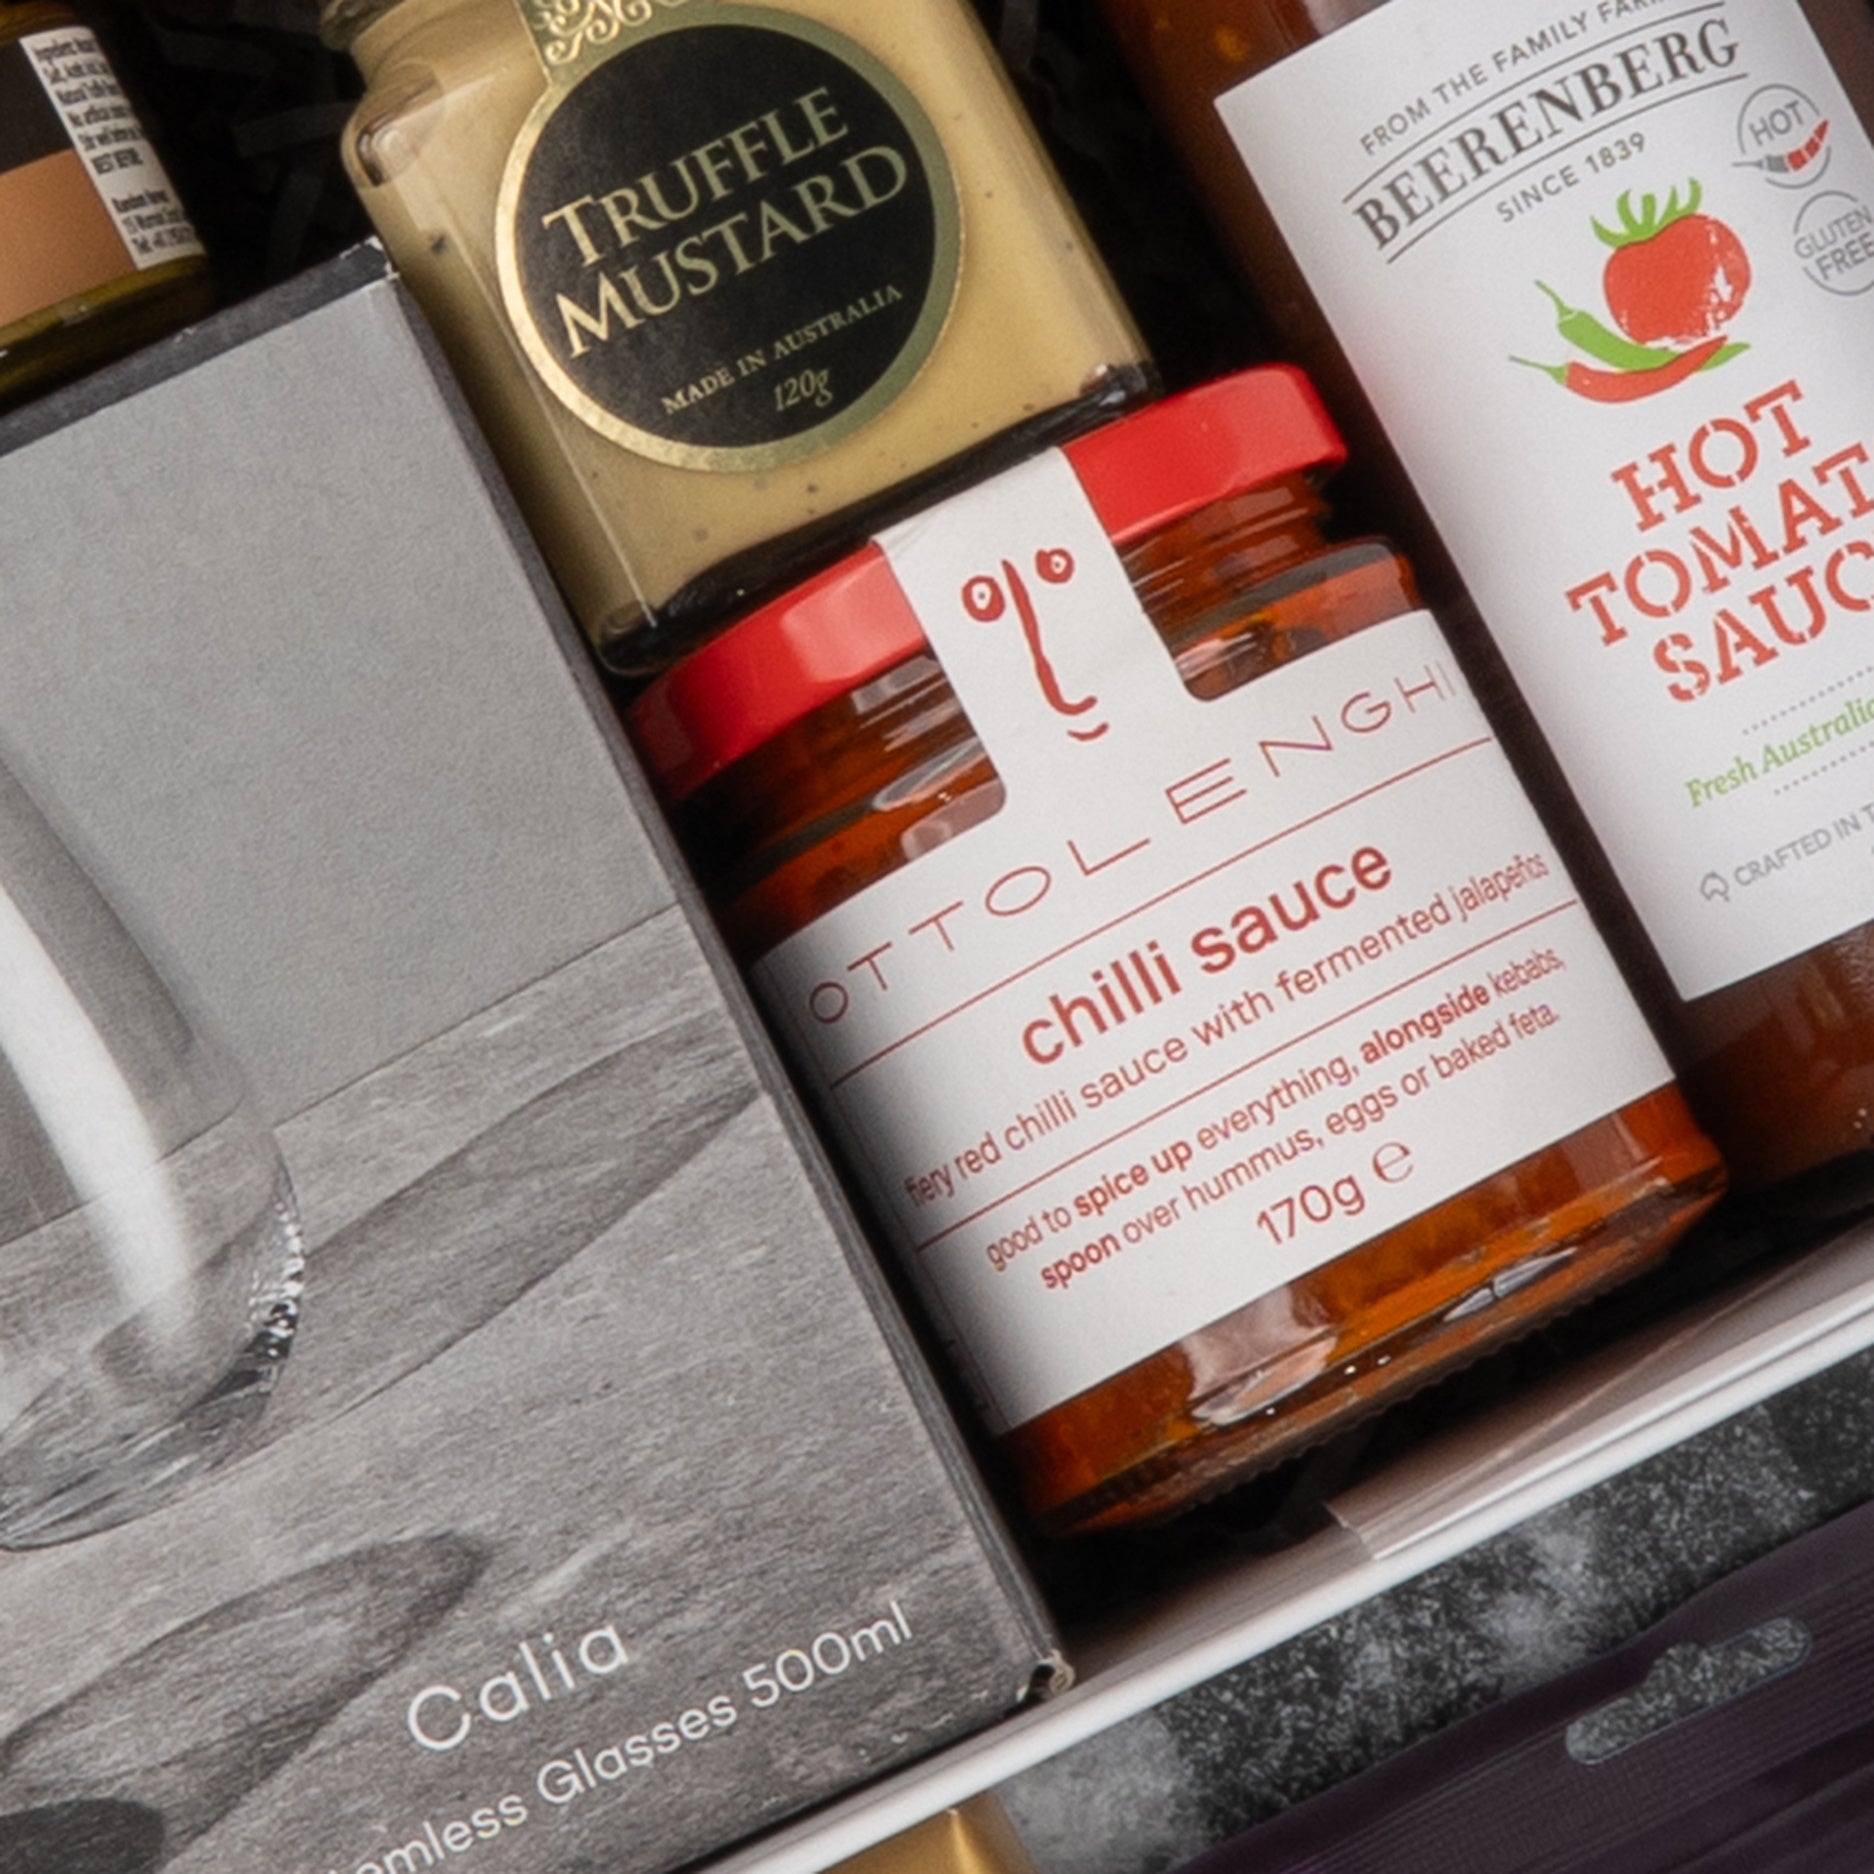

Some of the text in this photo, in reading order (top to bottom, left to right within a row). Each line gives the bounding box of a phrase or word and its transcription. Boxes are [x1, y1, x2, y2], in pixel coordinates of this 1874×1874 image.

[1353, 18, 1738, 250] BEERENBERG
[1360, 97, 1430, 155] FROM
[1432, 63, 1488, 104] THE
[1492, 11, 1588, 72] FAMILY
[1749, 99, 1804, 147] HOT
[542, 87, 848, 268] TRUFFLE
[556, 145, 908, 359] MUSTARD
[1497, 131, 1645, 222] SINCE 1839
[1794, 205, 1873, 259] GLUTEN
[1815, 230, 1874, 280] FREE
[662, 284, 903, 415] MADE IN AUSTRALIA
[773, 367, 834, 413] 120g
[1610, 379, 1812, 533] HOT
[1564, 442, 1874, 647] TOMAT
[1653, 540, 1874, 702] SAUC
[809, 661, 1457, 1024] OTTOLENGHI
[1685, 756, 1759, 808] Fresh
[1733, 828, 1831, 886] CRAFTED
[1832, 811, 1862, 839] IN
[1022, 845, 1392, 1065] chilli sauce
[903, 1162, 956, 1207] fiery
[954, 1131, 1002, 1180] red
[1004, 1090, 1077, 1151] chilli
[1080, 1037, 1189, 1108] sauce
[1190, 990, 1275, 1047] with
[1275, 893, 1451, 1002] fermented
[986, 1216, 1043, 1272] good
[1042, 1206, 1072, 1233] to
[1073, 1164, 1149, 1216] spice
[1151, 1140, 1193, 1172] up
[1196, 1057, 1360, 1150] everything,
[1360, 983, 1490, 1064] alongside
[1040, 1233, 1121, 1289] spoon
[1122, 1198, 1180, 1244] over
[1182, 1127, 1325, 1211] hummus,
[1325, 1085, 1398, 1137] eggs
[1401, 1066, 1430, 1097] or
[1430, 1019, 1511, 1079] baked
[1256, 1174, 1366, 1245] 170g
[406, 1624, 631, 1750] Calia
[536, 1694, 738, 1806] Glasses
[742, 1600, 914, 1709] 500ml
